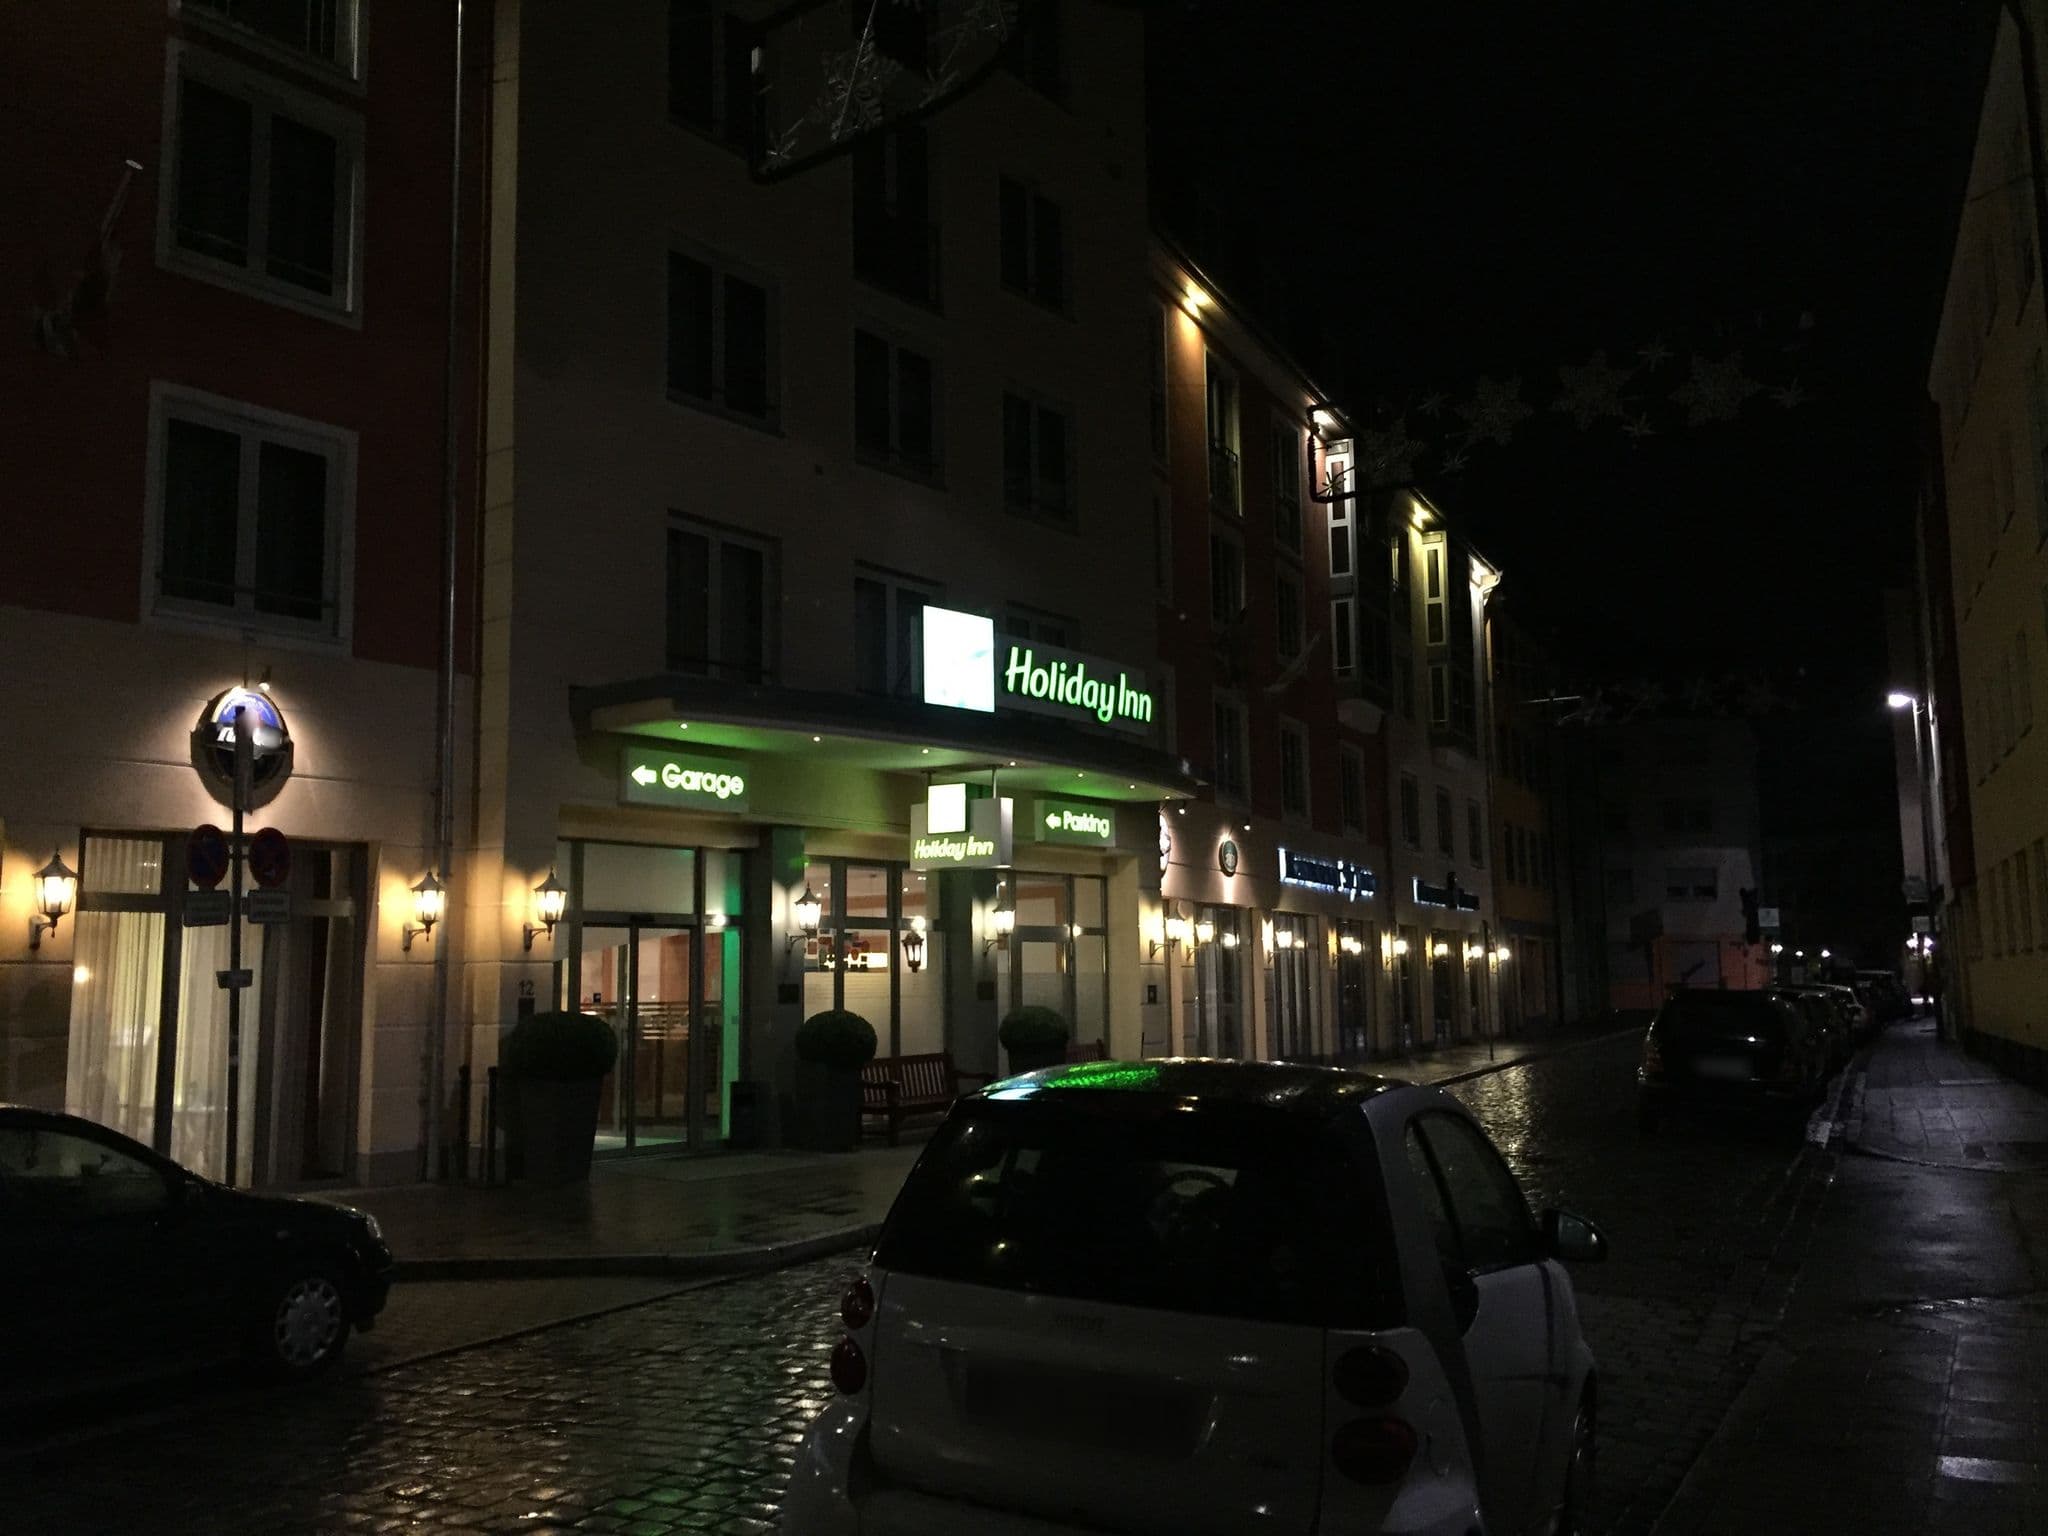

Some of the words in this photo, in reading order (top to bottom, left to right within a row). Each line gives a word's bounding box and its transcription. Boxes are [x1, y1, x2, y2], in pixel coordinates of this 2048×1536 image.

[1005, 646, 1116, 722] Holiday
[1118, 672, 1153, 723] Inn
[661, 763, 744, 799] Garage
[1063, 810, 1110, 838] Parking
[914, 837, 965, 861] Holiday
[967, 836, 993, 856] Inn
